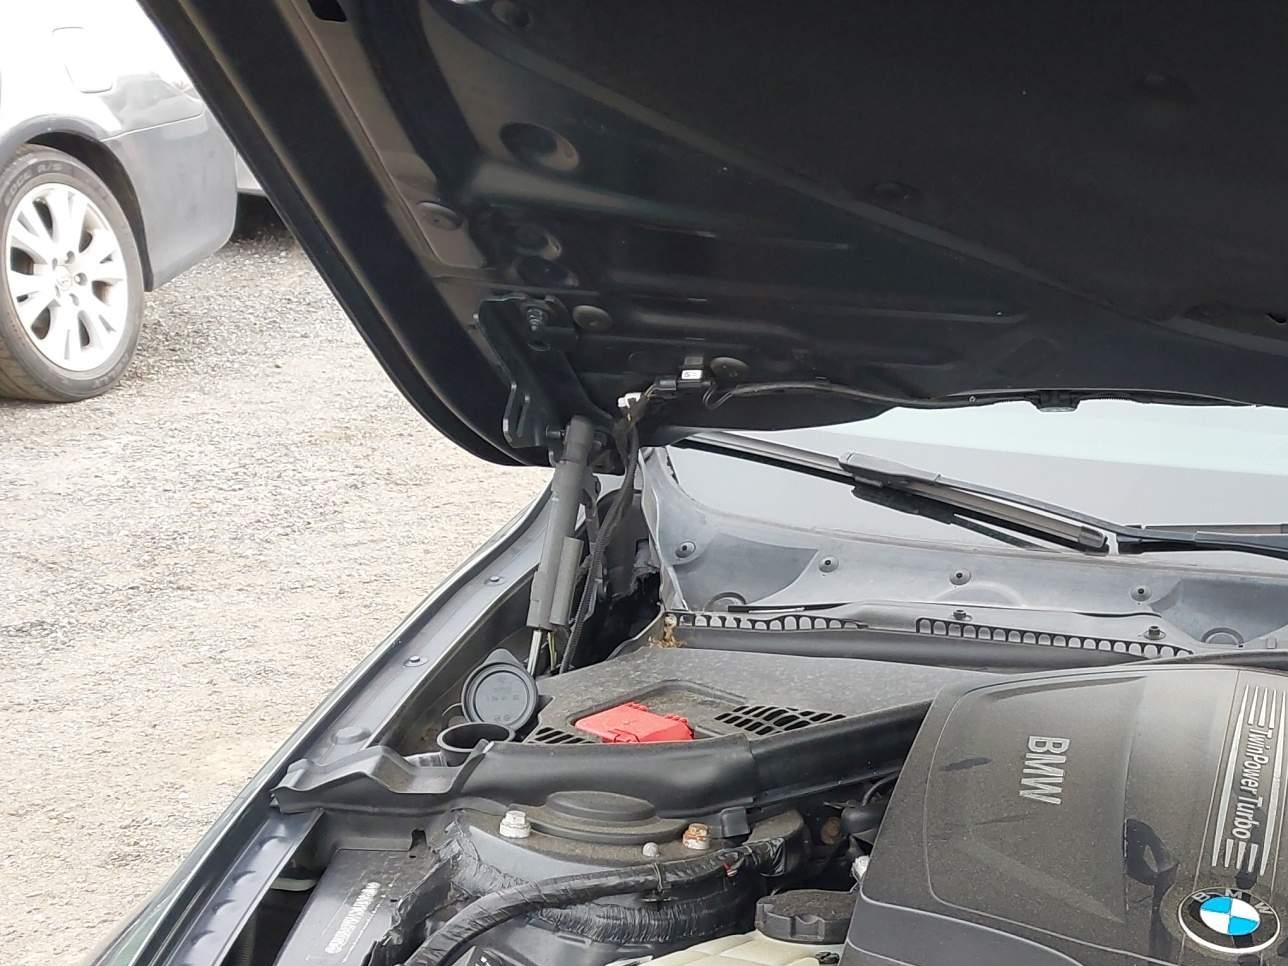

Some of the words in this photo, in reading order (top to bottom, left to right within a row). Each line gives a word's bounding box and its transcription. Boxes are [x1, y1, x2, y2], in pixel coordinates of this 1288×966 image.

[1019, 735, 1070, 804] BMW
[1240, 728, 1273, 795] TwinPower
[1232, 796, 1263, 839] Turbo
